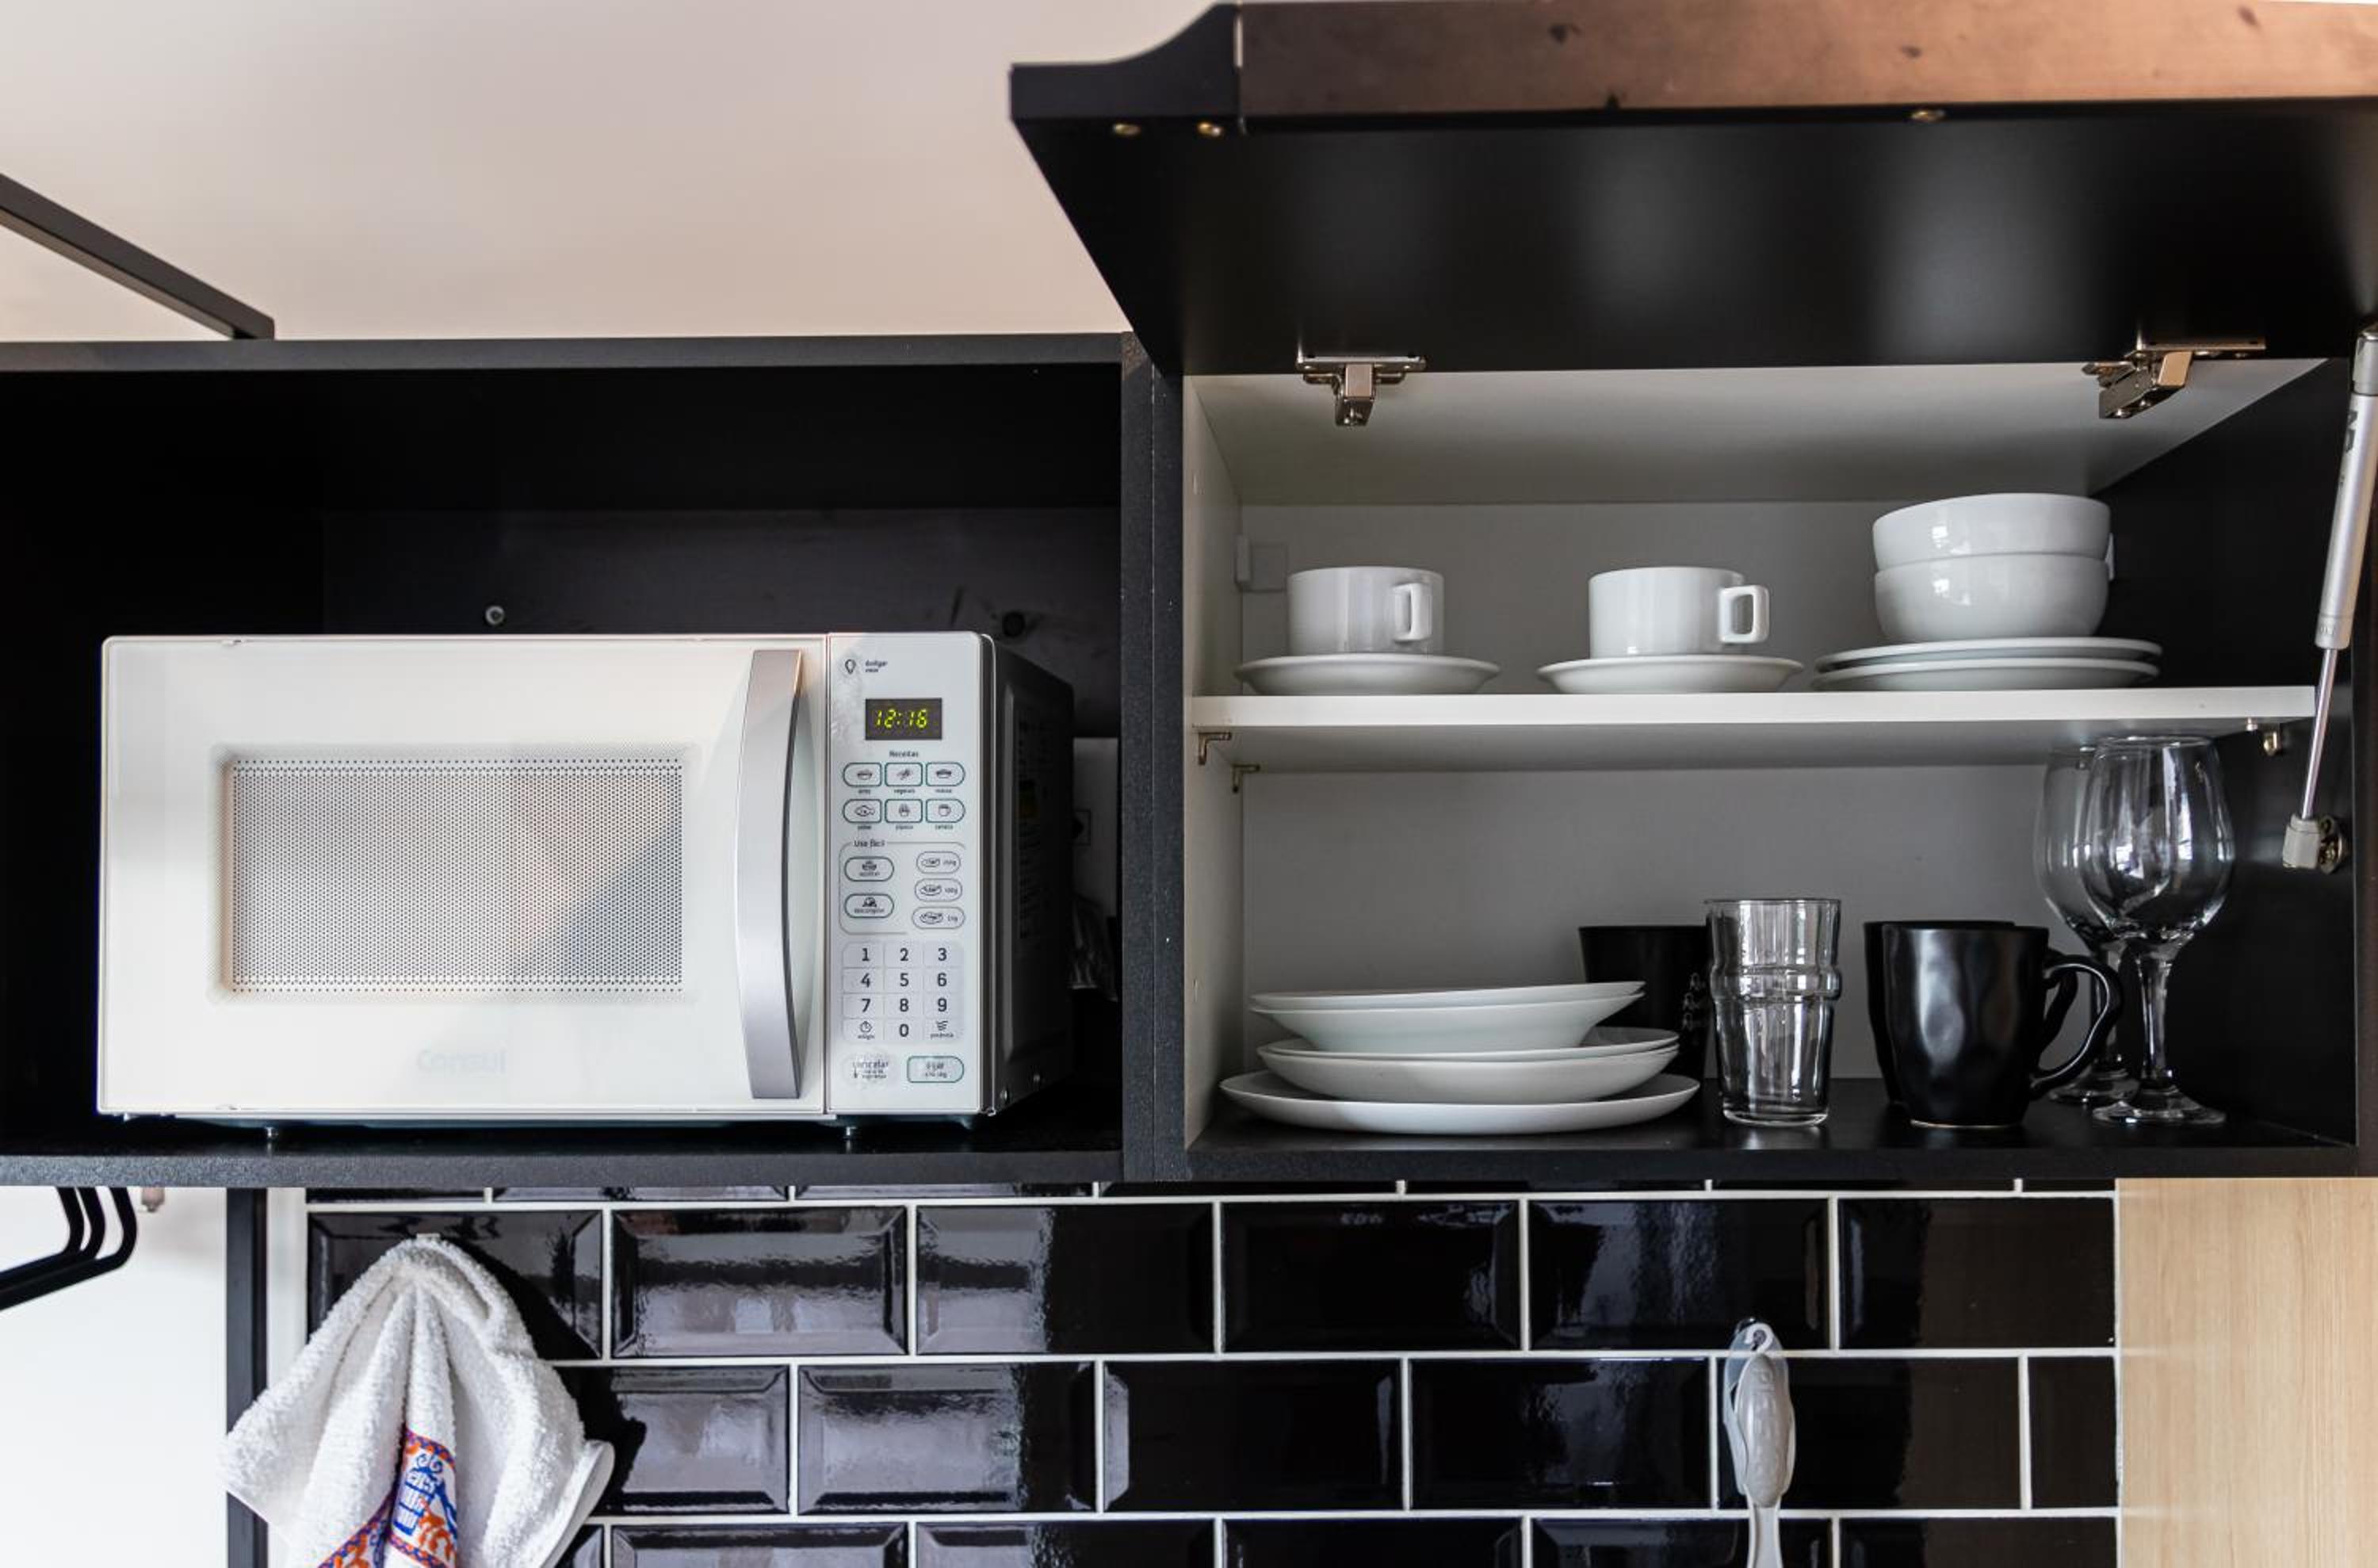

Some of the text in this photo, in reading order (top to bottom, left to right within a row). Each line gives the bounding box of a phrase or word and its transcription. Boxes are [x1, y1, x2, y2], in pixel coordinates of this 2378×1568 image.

[875, 708, 928, 729] 12:16
[862, 948, 870, 962] 1
[900, 948, 909, 962] 2
[938, 948, 947, 962] 3
[860, 973, 871, 988] 4
[900, 973, 909, 987] 5
[937, 972, 947, 987] 6
[862, 998, 871, 1013] 7
[899, 998, 909, 1012] 8
[937, 998, 947, 1012] 9
[899, 1023, 909, 1038] 0
